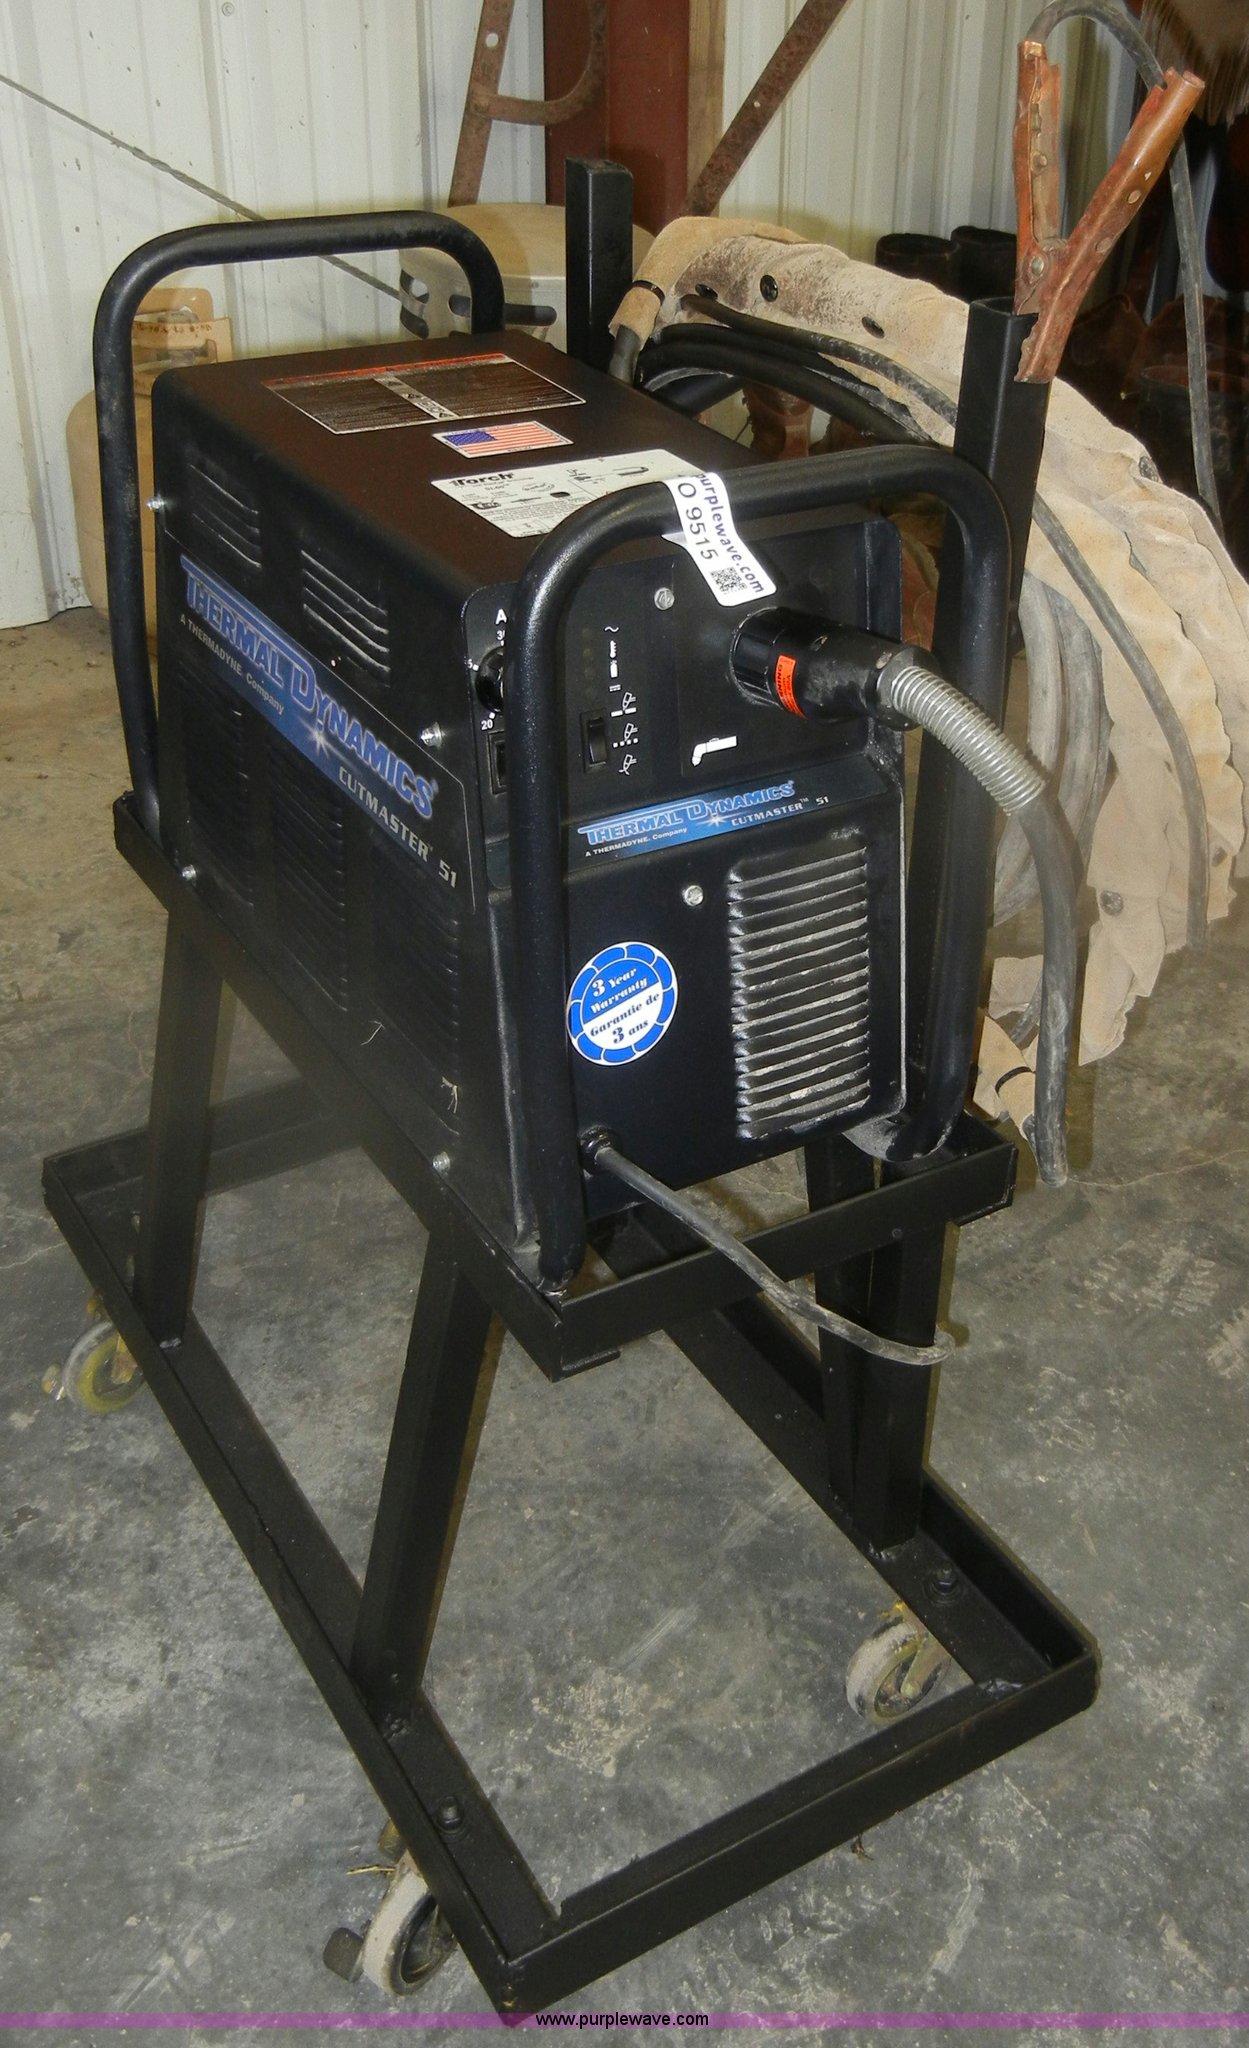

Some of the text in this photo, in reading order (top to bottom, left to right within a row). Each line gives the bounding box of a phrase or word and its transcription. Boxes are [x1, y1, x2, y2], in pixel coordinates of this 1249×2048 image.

[686, 507, 719, 559] 9515
[697, 474, 764, 593] purplewave.com
[180, 554, 284, 688] THERMAL
[495, 609, 507, 625] A
[180, 613, 285, 716] A THERMADYNE Company
[481, 720, 493, 730] 20
[816, 796, 829, 806] 51
[578, 805, 684, 846] THERMAL
[585, 850, 592, 858] A
[652, 827, 687, 841] Company
[439, 859, 457, 888] 51
[590, 978, 648, 1014] Warranty
[592, 968, 637, 997] 3 Year
[590, 993, 660, 1037] Garantie de
[612, 1020, 648, 1044] 3 ans
